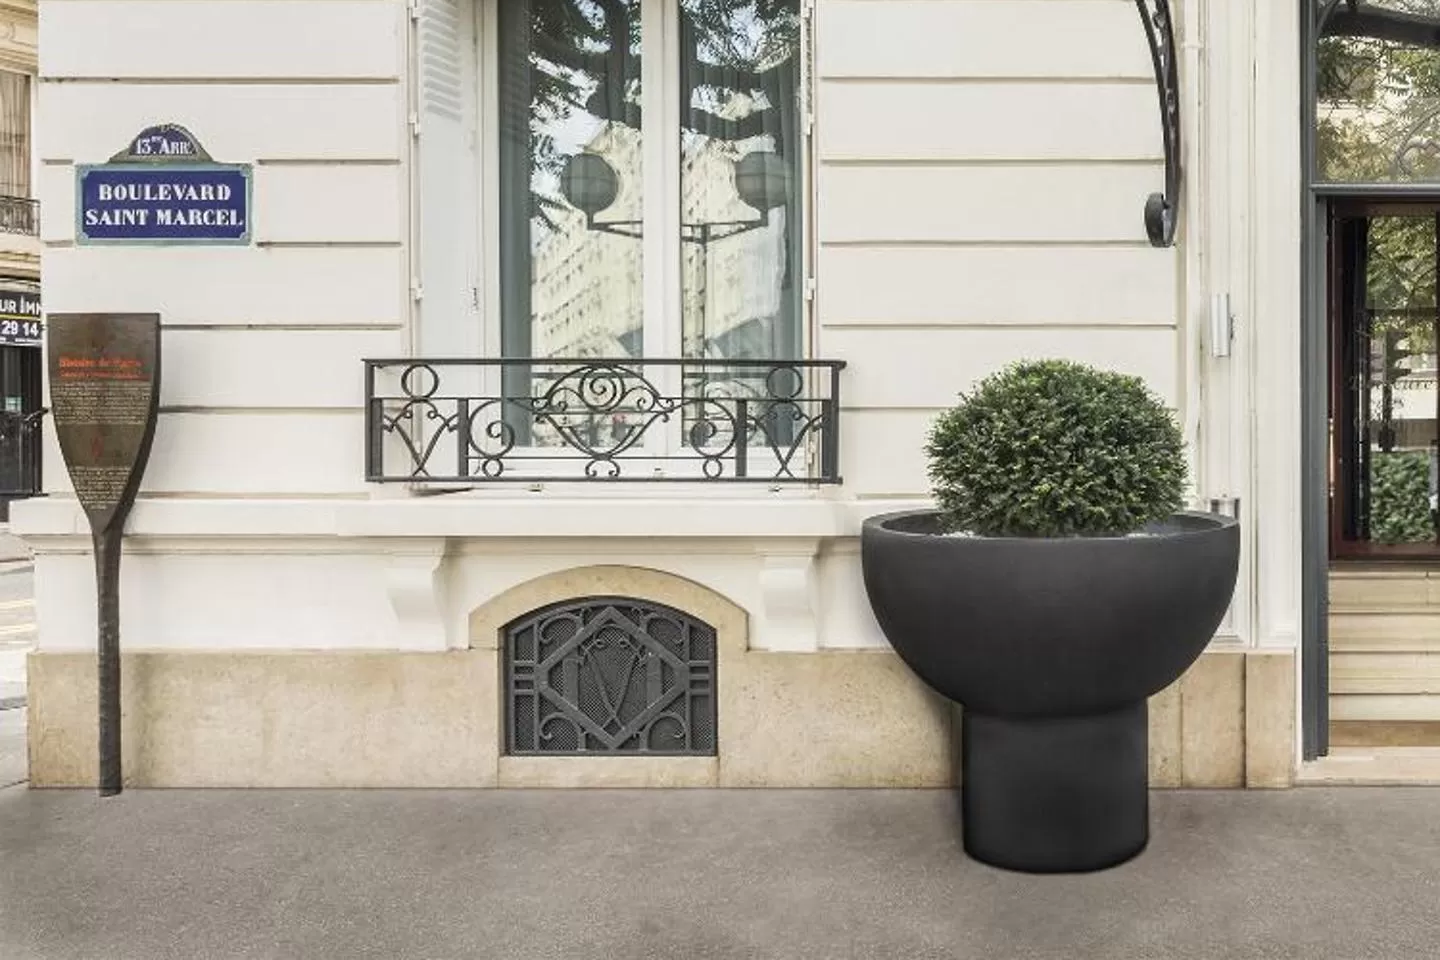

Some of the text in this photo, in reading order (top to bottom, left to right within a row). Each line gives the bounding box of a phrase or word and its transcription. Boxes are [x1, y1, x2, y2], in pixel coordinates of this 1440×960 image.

[99, 184, 231, 201] BOULEVARD
[85, 209, 243, 225] SAINT MARCEL
[22, 322, 39, 337] 14
